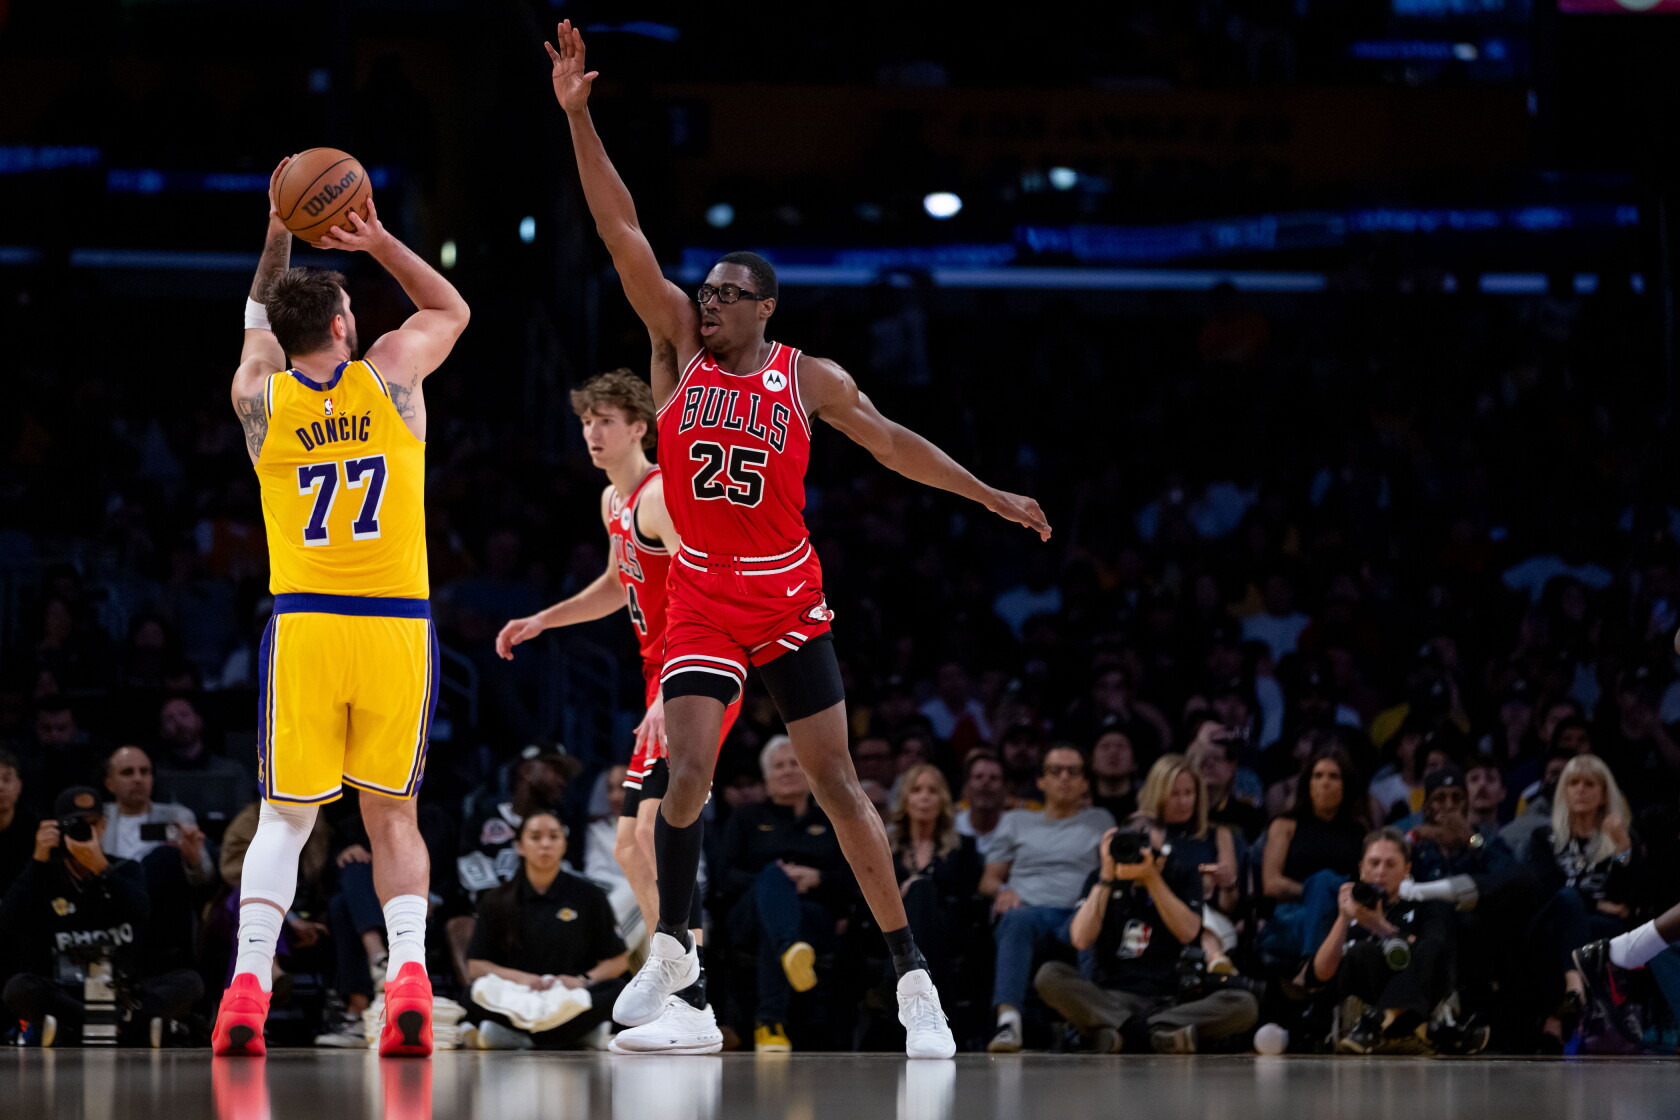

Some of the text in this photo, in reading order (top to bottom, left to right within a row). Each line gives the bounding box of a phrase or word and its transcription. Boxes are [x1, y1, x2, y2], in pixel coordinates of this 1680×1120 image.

[302, 170, 358, 217] Wilson
[295, 410, 372, 452] DONČIĆ
[678, 385, 791, 455] BULLS
[296, 453, 389, 547] 77
[689, 440, 769, 508] 25
